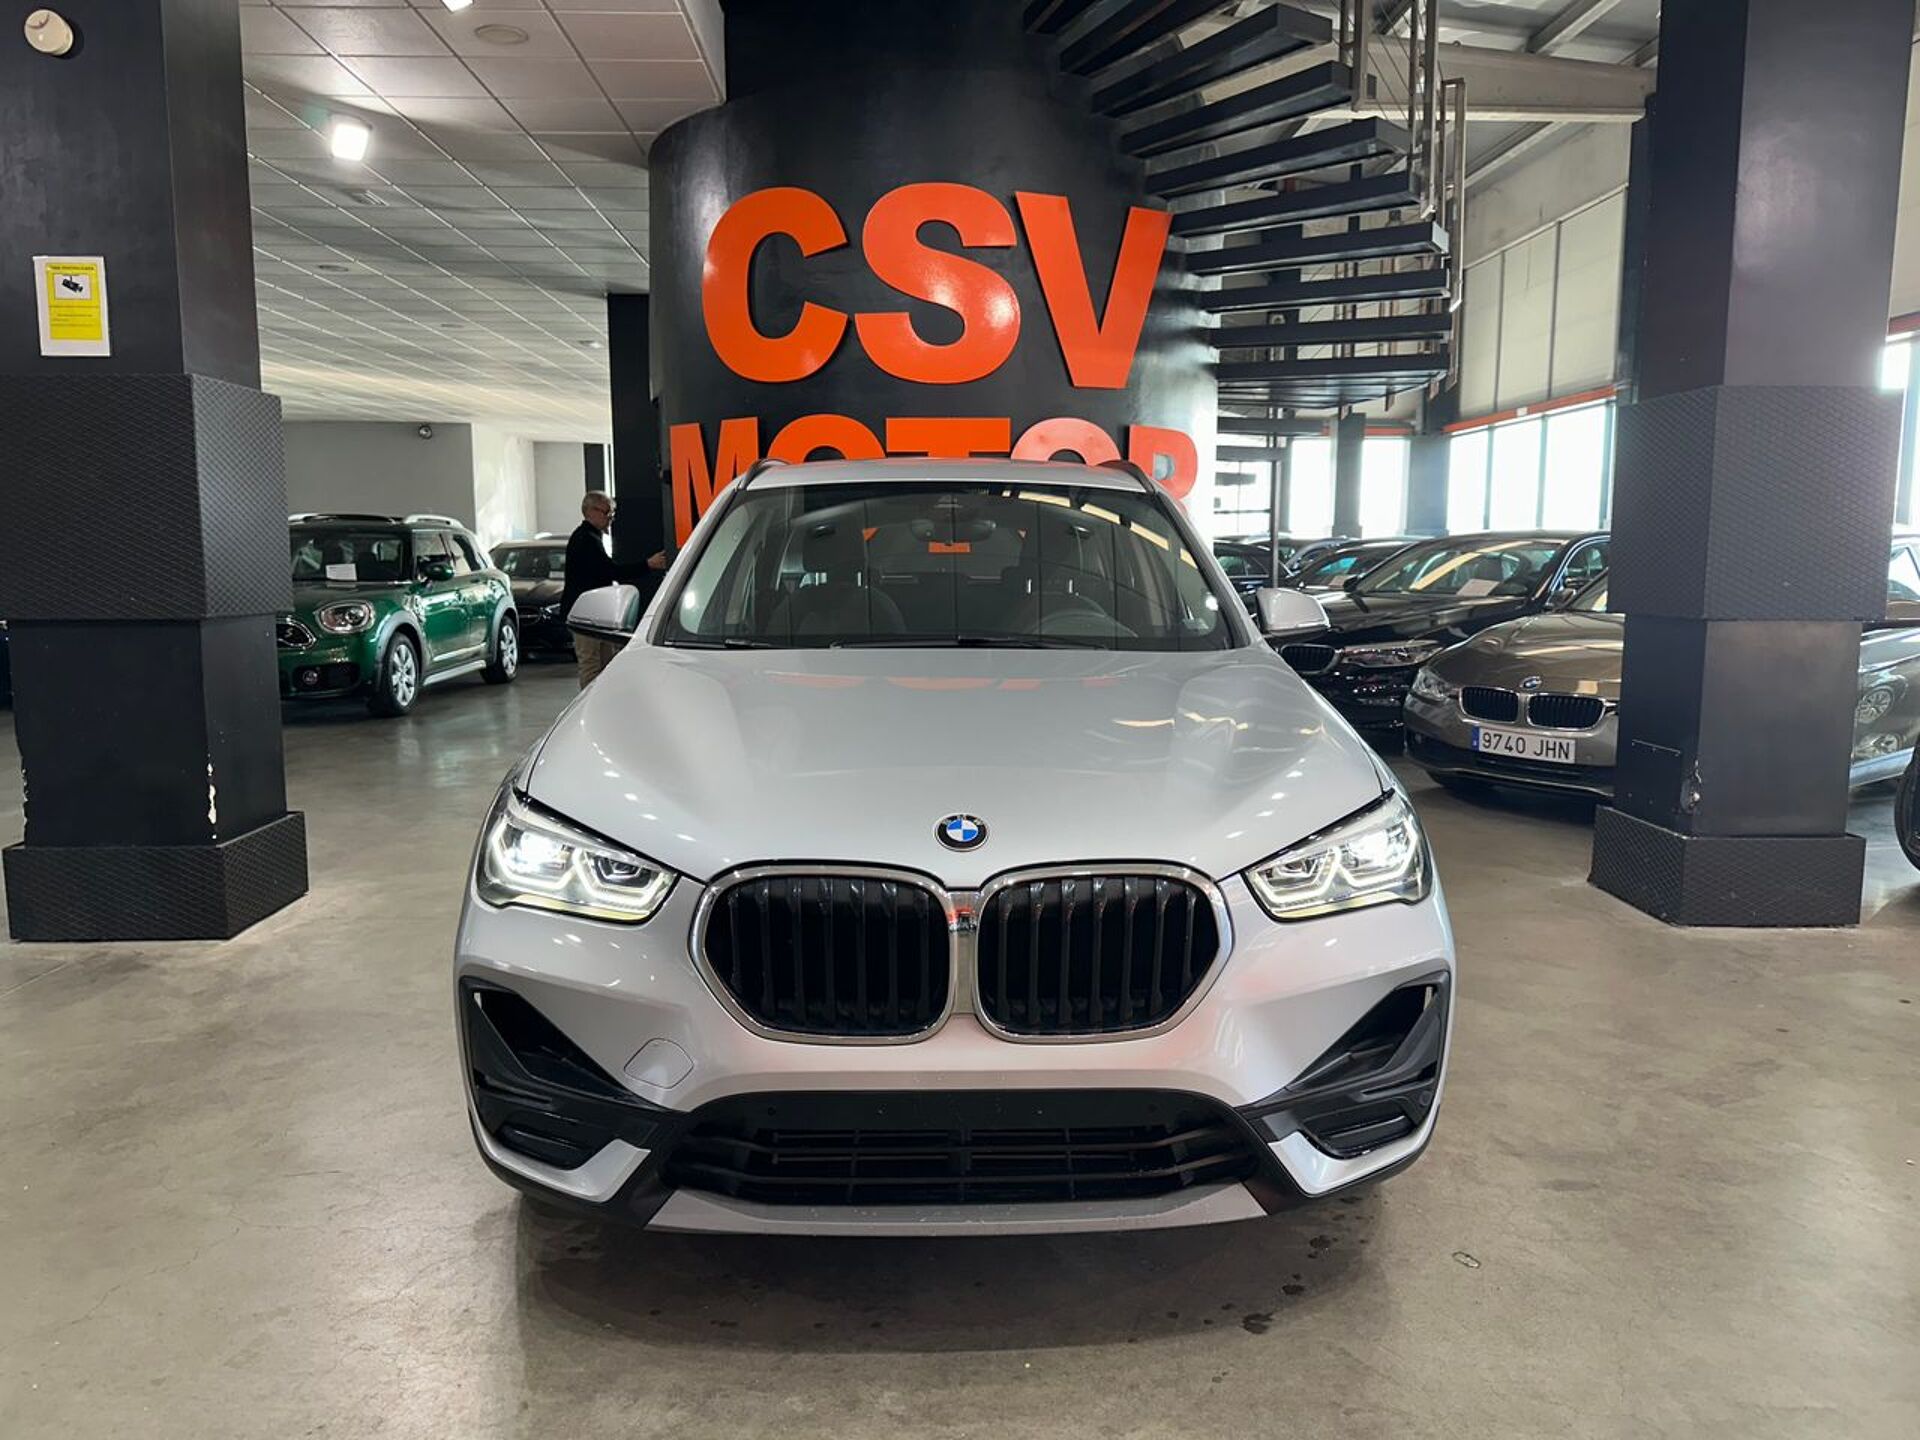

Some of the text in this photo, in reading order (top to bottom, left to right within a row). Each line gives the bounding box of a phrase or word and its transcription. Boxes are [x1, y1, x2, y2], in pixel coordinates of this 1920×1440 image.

[702, 182, 1172, 389] CSV
[1482, 732, 1570, 760] 9740 JHN
